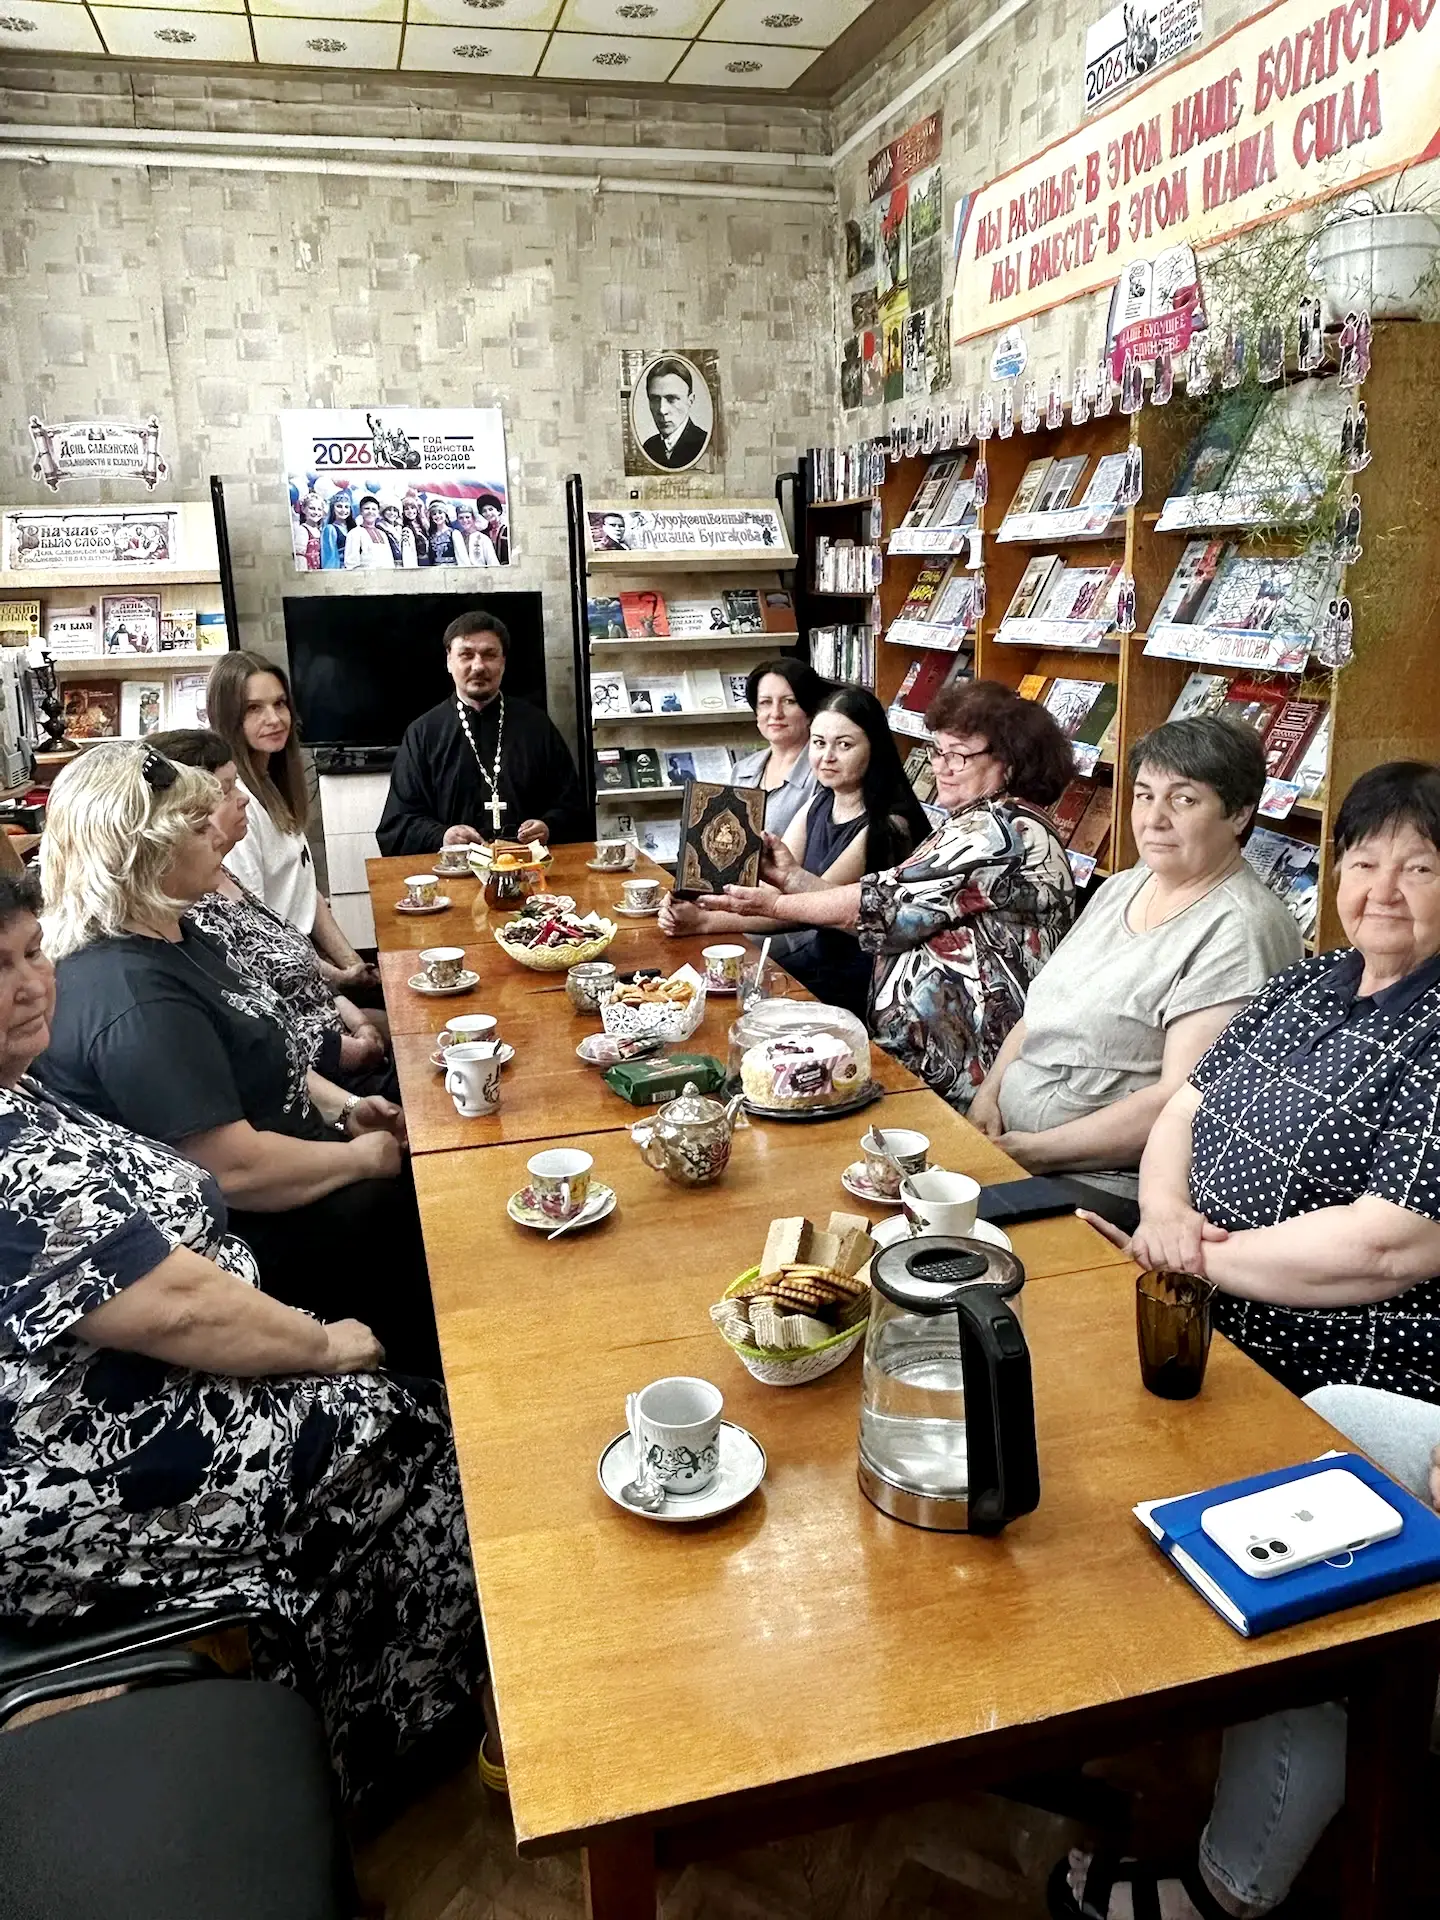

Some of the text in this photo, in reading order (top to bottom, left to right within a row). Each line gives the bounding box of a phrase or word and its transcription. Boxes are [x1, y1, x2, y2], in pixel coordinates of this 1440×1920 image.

[1086, 50, 1122, 102] 2026
[975, 206, 1002, 260] МЫ
[1107, 112, 1162, 190] ЭТОМ
[1170, 67, 1244, 159] НАШЕ
[989, 251, 1022, 304] МЫ
[1128, 166, 1189, 243] ЭТОМ
[1203, 121, 1278, 214] НАША
[1293, 68, 1383, 169] СИЛА
[1143, 313, 1186, 339] БУДУЩЕЕ
[422, 436, 442, 444] ГОД
[313, 443, 372, 465] 2026
[424, 454, 471, 462] НАРОДОВ
[425, 462, 465, 470] РОССИИ
[699, 528, 762, 547] Булгакова
